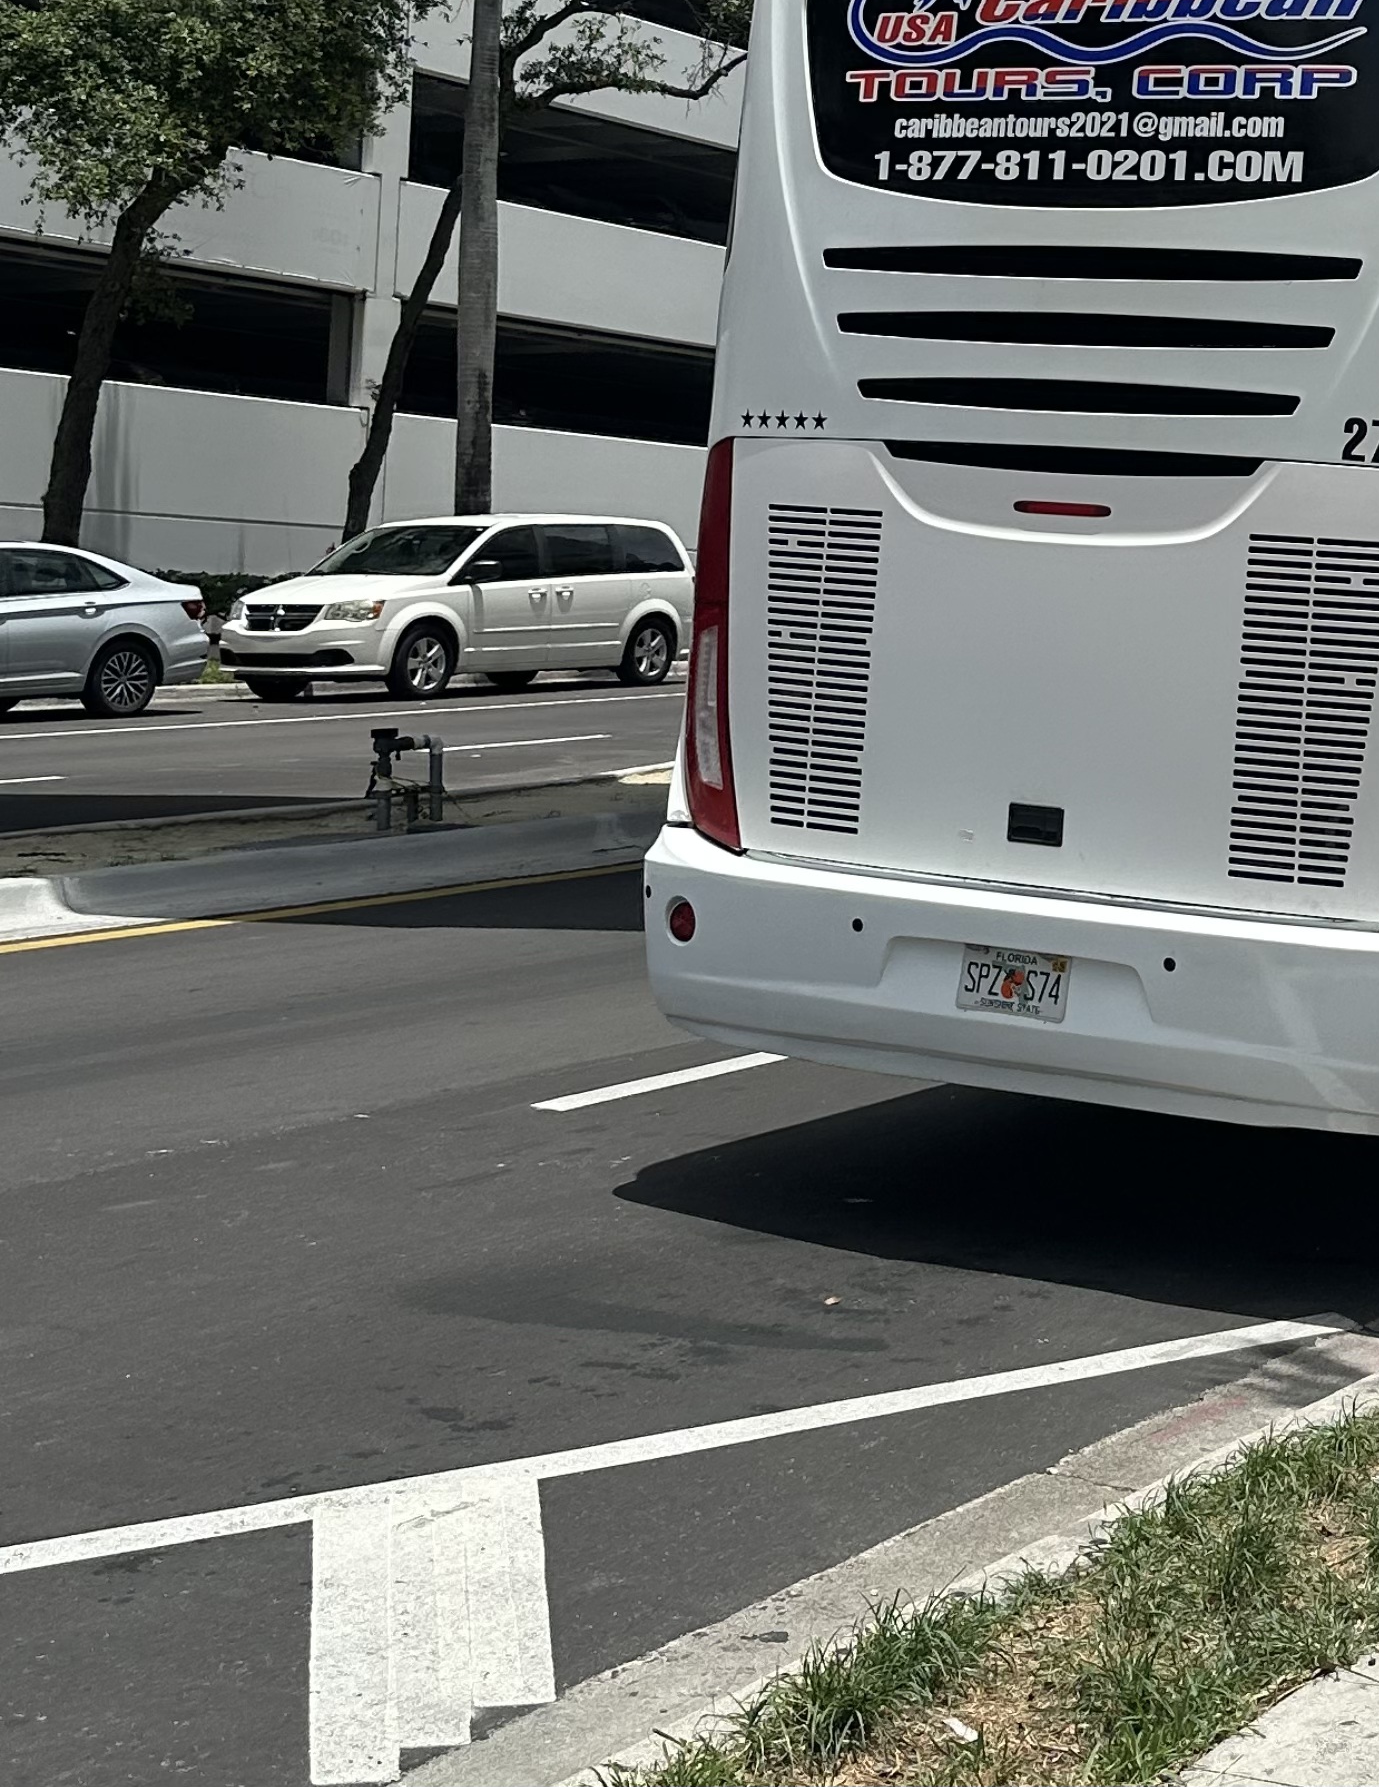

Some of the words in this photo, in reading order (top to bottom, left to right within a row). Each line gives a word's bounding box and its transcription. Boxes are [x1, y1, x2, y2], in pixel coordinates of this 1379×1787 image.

[874, 12, 957, 45] USA
[846, 67, 1111, 104] TOURS,
[1131, 66, 1357, 101] CORP
[894, 112, 1285, 140] caribbeantours2021@gmail.com
[874, 148, 1303, 183] 1-877-811-0201.COM
[996, 951, 1038, 966] FLORIDA
[964, 961, 1002, 996] SPZ
[1024, 970, 1062, 1006] S74
